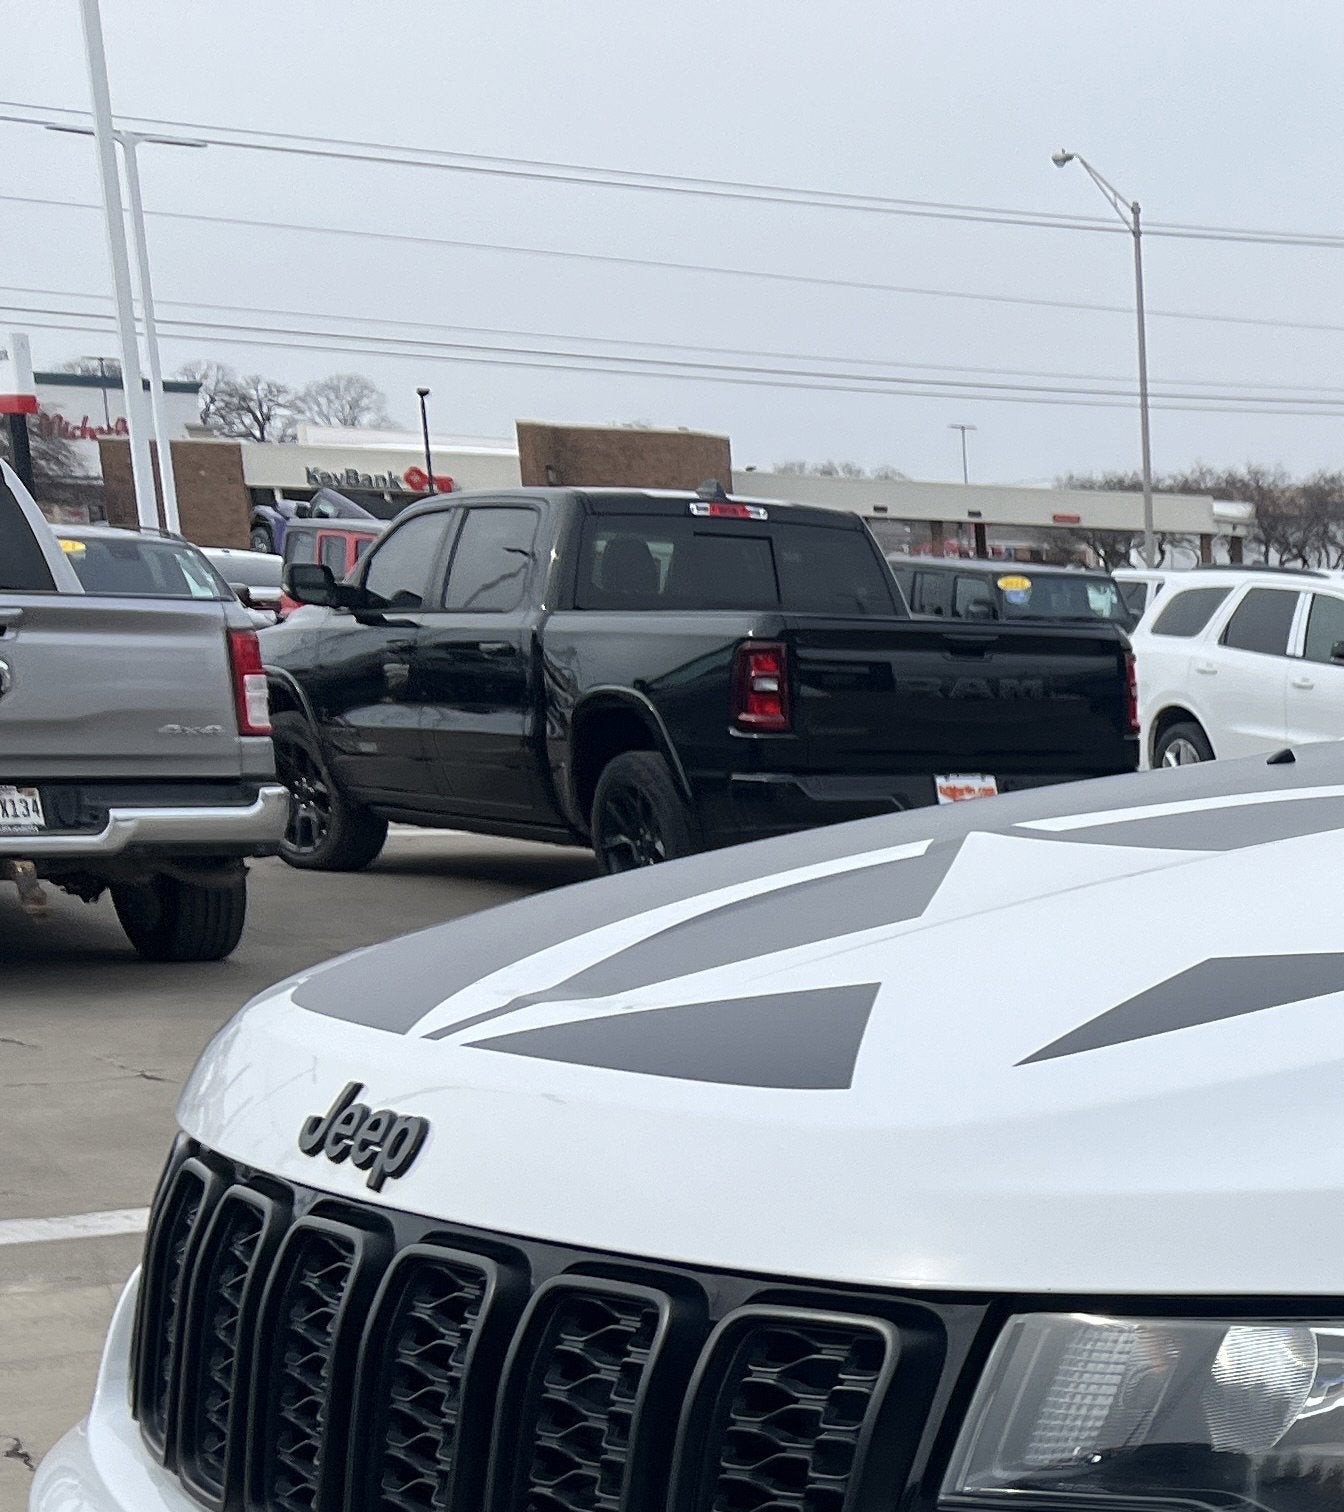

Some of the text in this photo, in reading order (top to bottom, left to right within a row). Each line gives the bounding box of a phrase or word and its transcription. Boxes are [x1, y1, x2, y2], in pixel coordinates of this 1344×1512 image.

[305, 466, 402, 491] KeyBank
[895, 675, 1045, 700] RAM
[298, 1080, 431, 1193] Jeep
